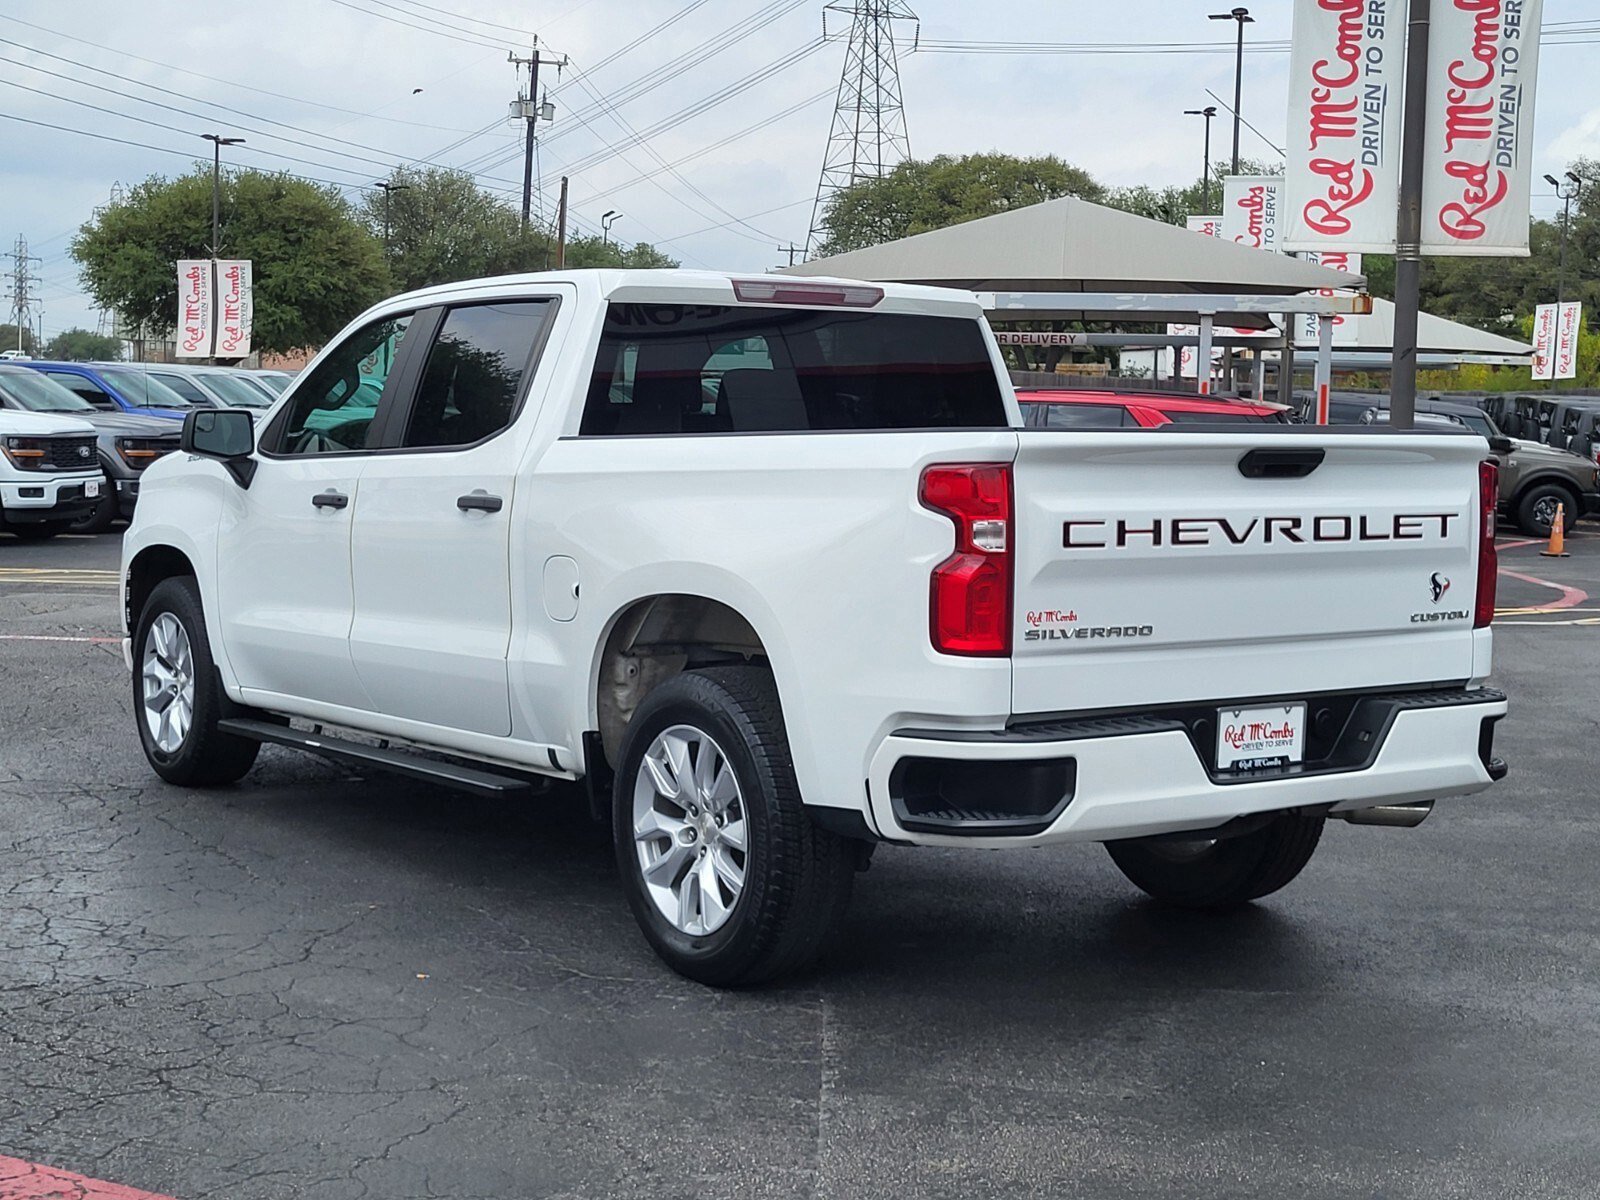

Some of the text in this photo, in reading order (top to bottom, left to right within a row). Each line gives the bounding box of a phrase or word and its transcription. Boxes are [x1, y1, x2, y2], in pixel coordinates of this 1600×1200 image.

[1309, 0, 1364, 151] McCom
[1361, 0, 1386, 167] DRIVEN TO SER
[1496, 0, 1523, 168] DRIVEN TO SER
[1438, 0, 1508, 240] Red McCom
[1265, 186, 1276, 225] SERVE
[1303, 158, 1374, 236] Red
[1235, 186, 1264, 248] Combs
[1264, 227, 1275, 245] TO
[182, 266, 205, 352] Red McCombs
[222, 266, 244, 352] Red McCombs
[1011, 334, 1077, 344] DELIVERY
[1062, 513, 1460, 549] CHEVROLET
[1024, 625, 1153, 641] SILVERADO
[1026, 610, 1078, 627] Red McCombs
[1410, 610, 1470, 623] CUSTOM
[1224, 721, 1294, 749] Red McCombs
[1243, 742, 1264, 750] DRIVEN
